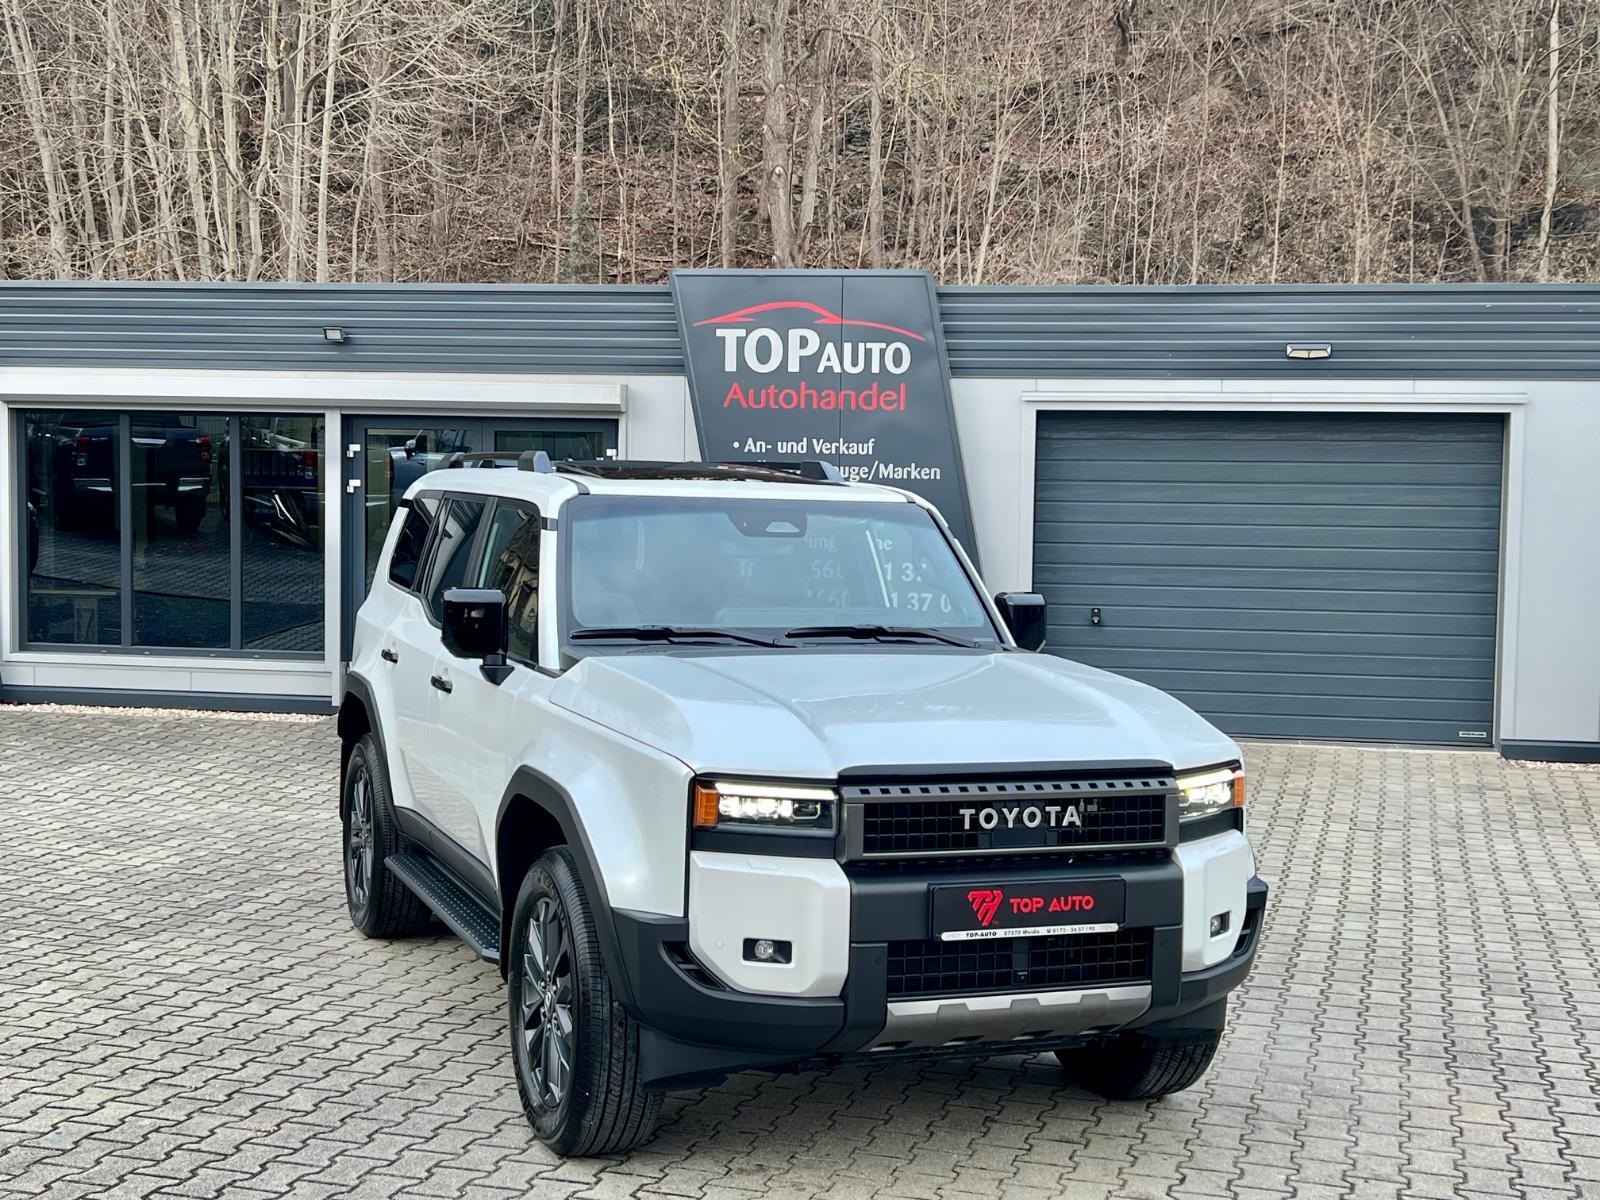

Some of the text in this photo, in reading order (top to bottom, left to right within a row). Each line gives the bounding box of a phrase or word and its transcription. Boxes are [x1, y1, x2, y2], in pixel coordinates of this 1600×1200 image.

[723, 381, 907, 411] Autohandel
[744, 437, 876, 455] An- und Verkauf
[835, 460, 941, 482] uge/Marken
[959, 805, 1082, 830] TOYOTA
[1009, 895, 1095, 914] TOP AUTO
